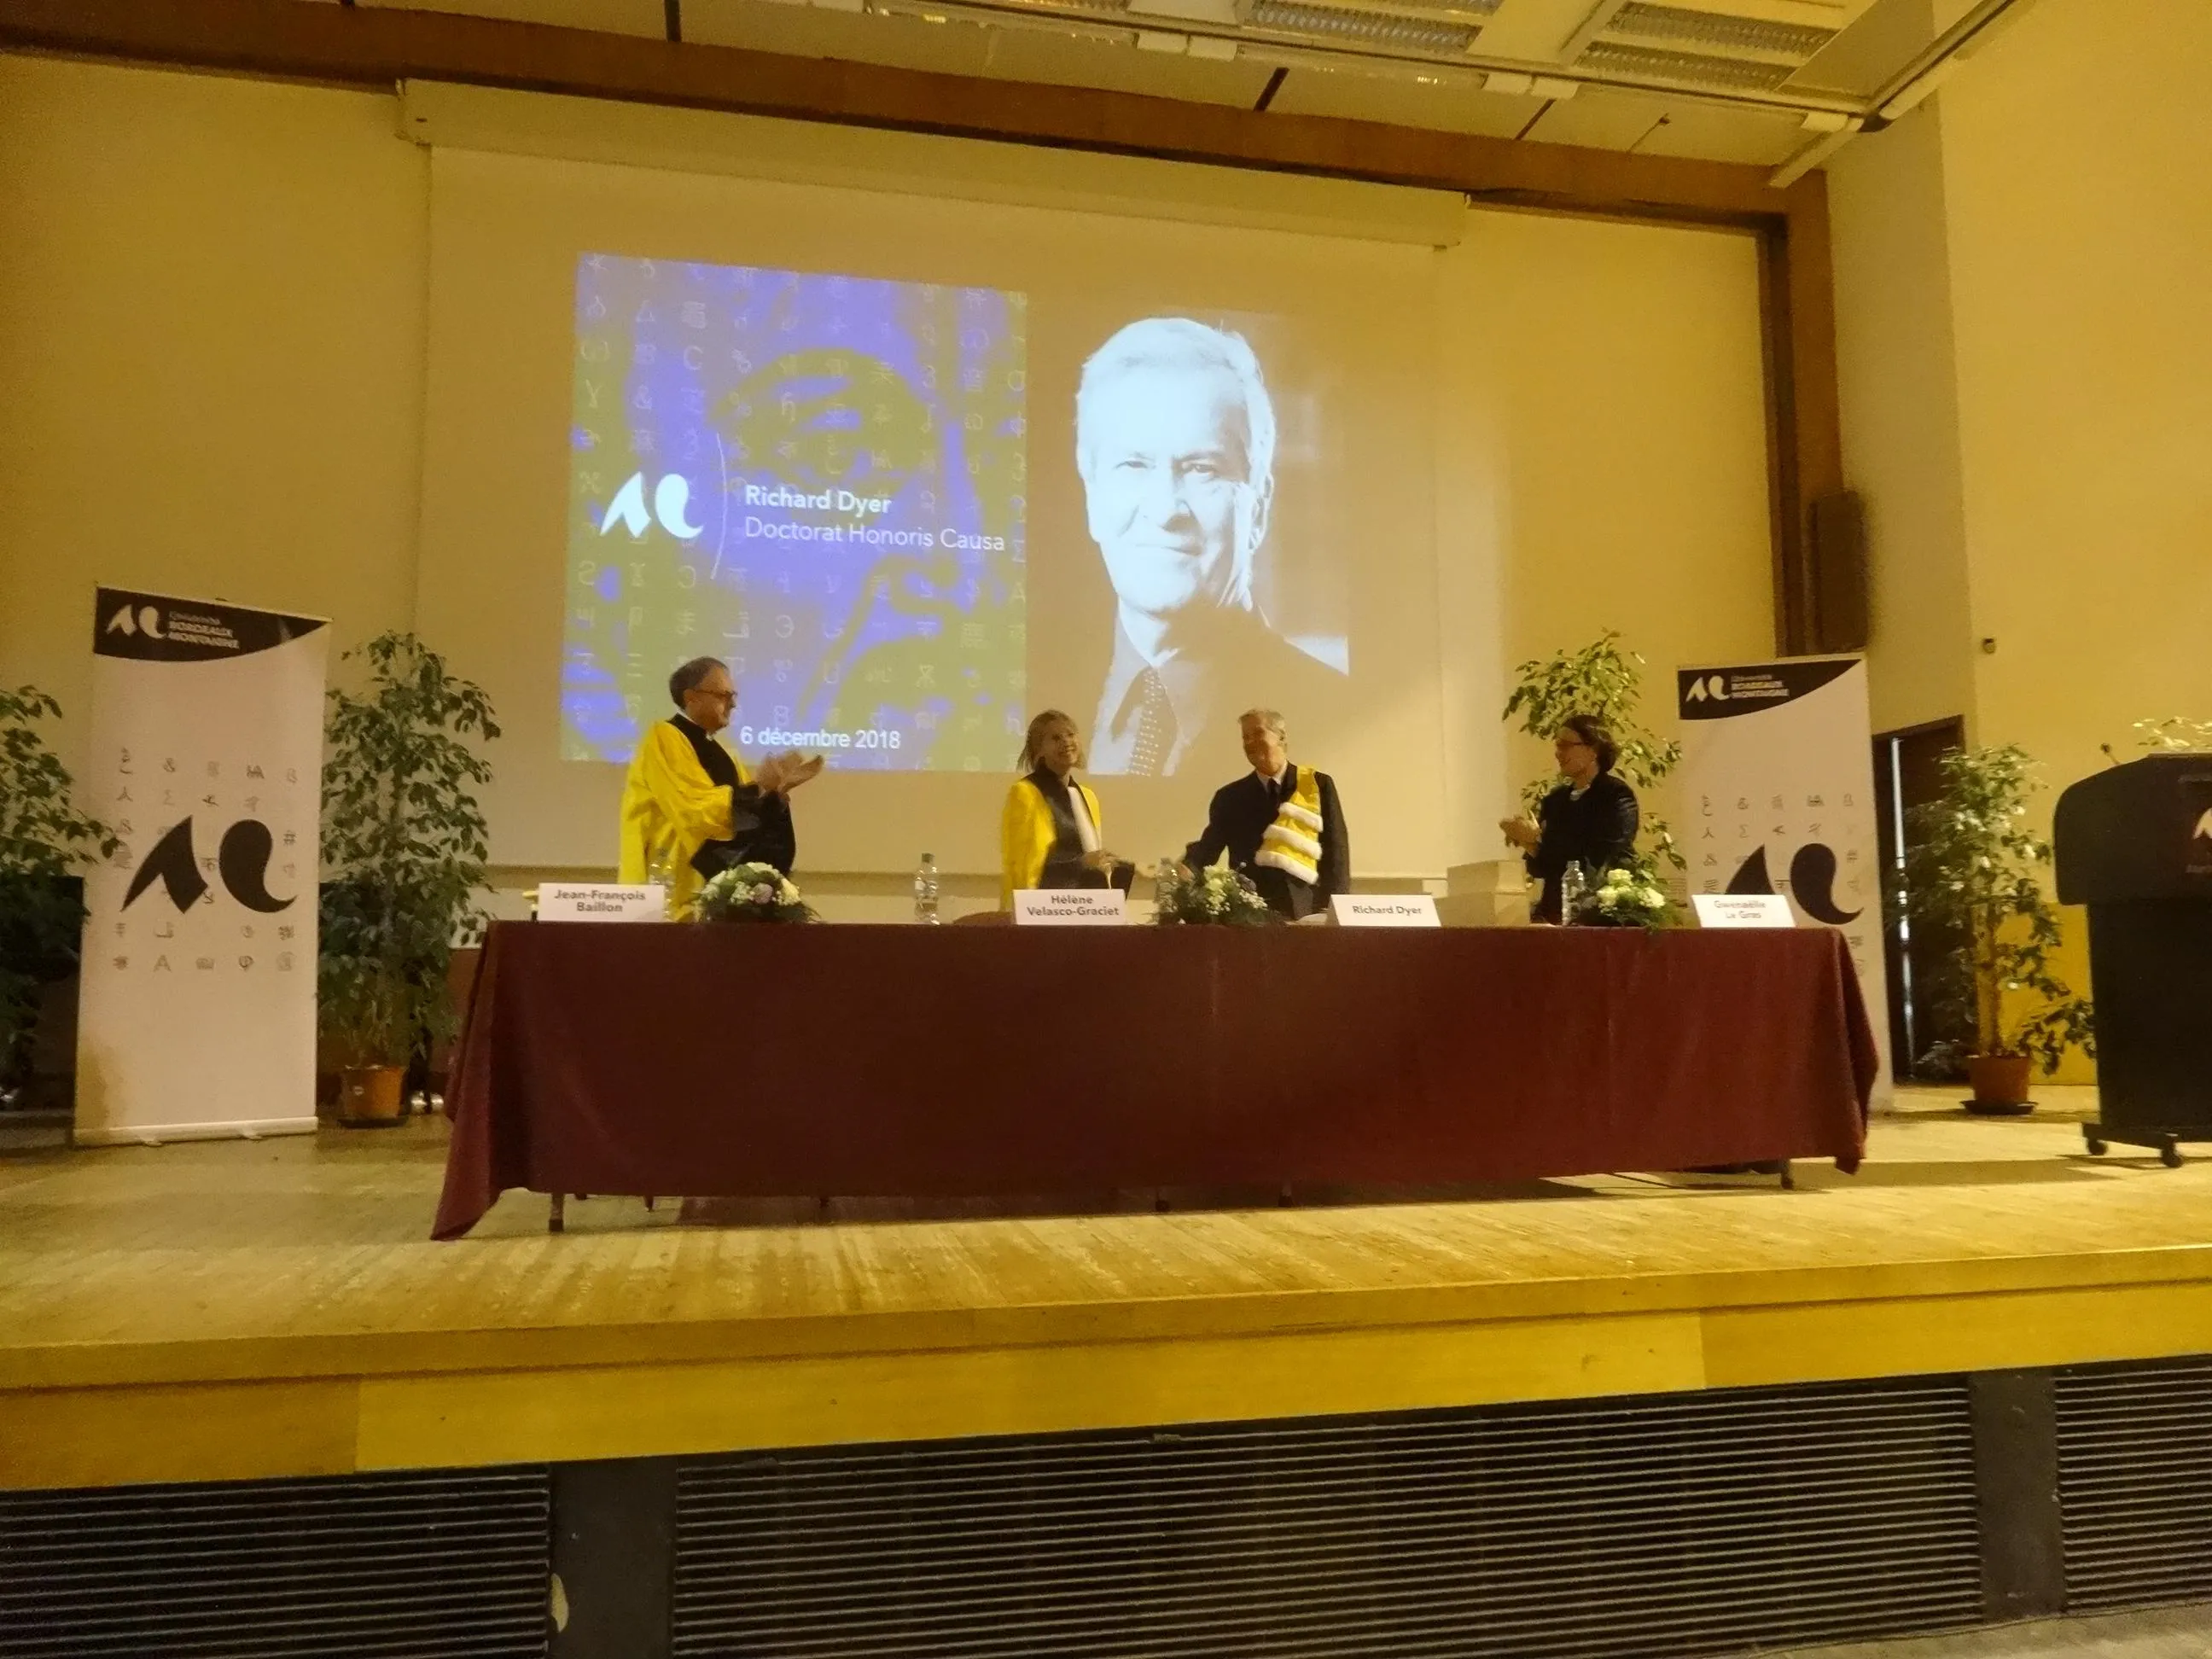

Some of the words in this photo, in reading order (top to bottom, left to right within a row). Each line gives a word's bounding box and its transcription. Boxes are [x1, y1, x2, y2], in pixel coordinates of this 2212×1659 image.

[744, 484, 831, 510] Richard
[837, 490, 894, 518] Dyer
[744, 516, 843, 543] Doctorat
[848, 523, 934, 547] Honoris
[940, 528, 1005, 551] Causa
[740, 725, 754, 745] 6
[758, 726, 851, 748] décembre
[854, 729, 901, 749] 2018
[554, 889, 646, 902] Jean-François
[1051, 894, 1094, 905] Hélène
[576, 901, 623, 912] Baillon
[1026, 905, 1120, 917] Velasco-Graciet
[1352, 905, 1394, 915] Richard
[1396, 905, 1422, 917] Dyer
